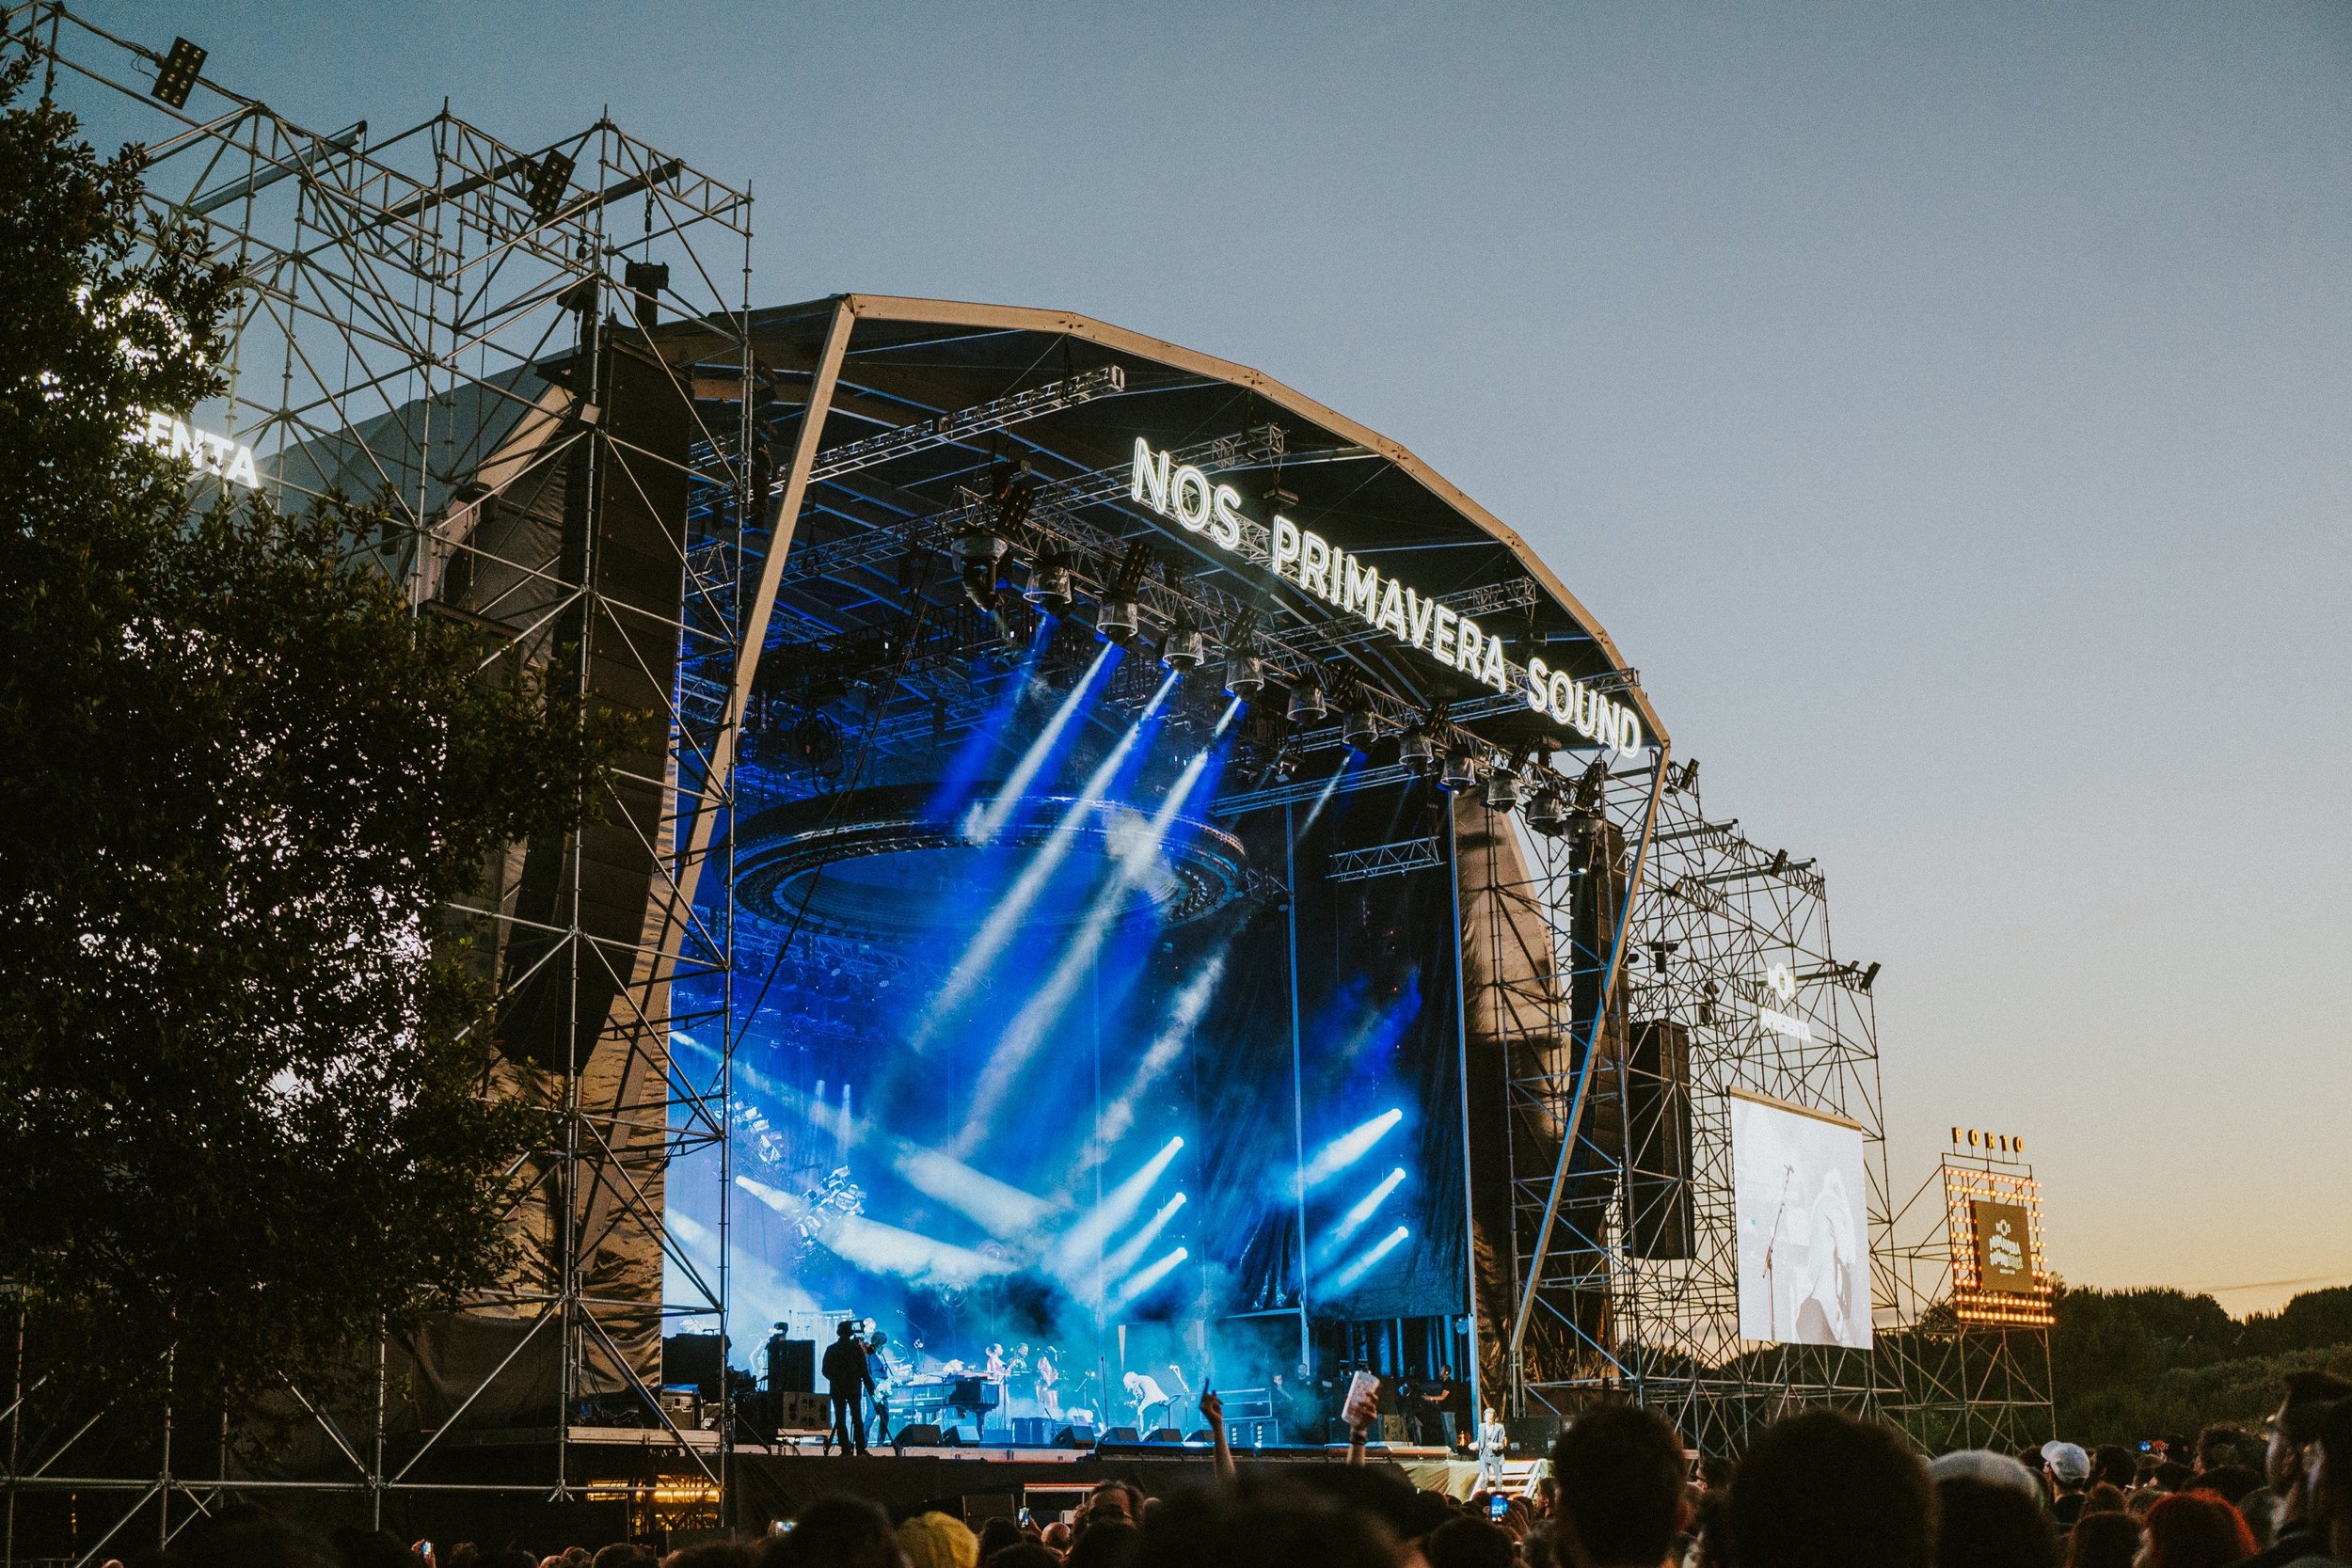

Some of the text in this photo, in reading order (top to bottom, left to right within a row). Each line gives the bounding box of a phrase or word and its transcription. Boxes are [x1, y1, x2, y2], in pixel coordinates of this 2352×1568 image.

[1132, 436, 1641, 759] NOS PRIMAVERA SOUND
[1951, 1127, 2023, 1152] PORTO
